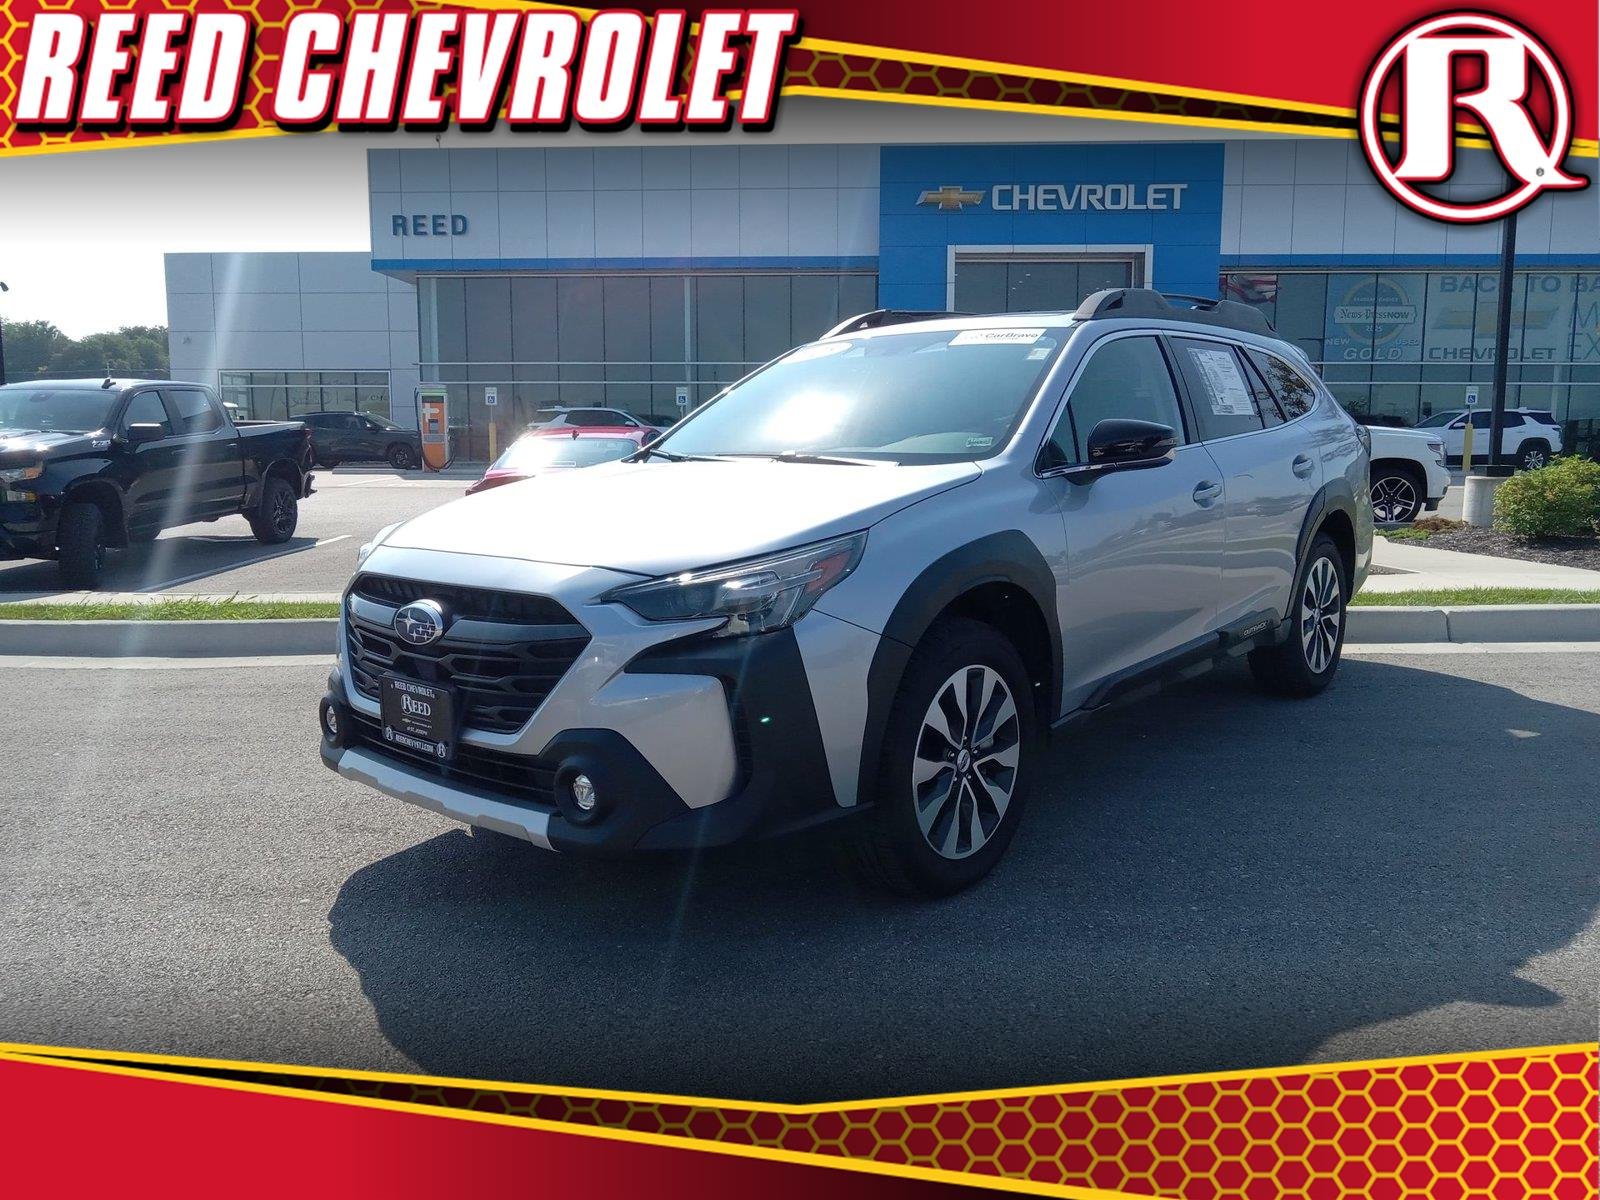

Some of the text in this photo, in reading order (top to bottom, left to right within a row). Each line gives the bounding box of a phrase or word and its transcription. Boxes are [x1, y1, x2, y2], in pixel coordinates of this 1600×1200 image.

[991, 183, 1188, 211] CHEVROLET
[391, 214, 469, 236] REED
[1440, 276, 1514, 293] BAC
[1527, 276, 1562, 293] TO
[1343, 347, 1403, 360] GOLD
[1428, 347, 1557, 360] CHEVROLET
[401, 693, 431, 716] REED
